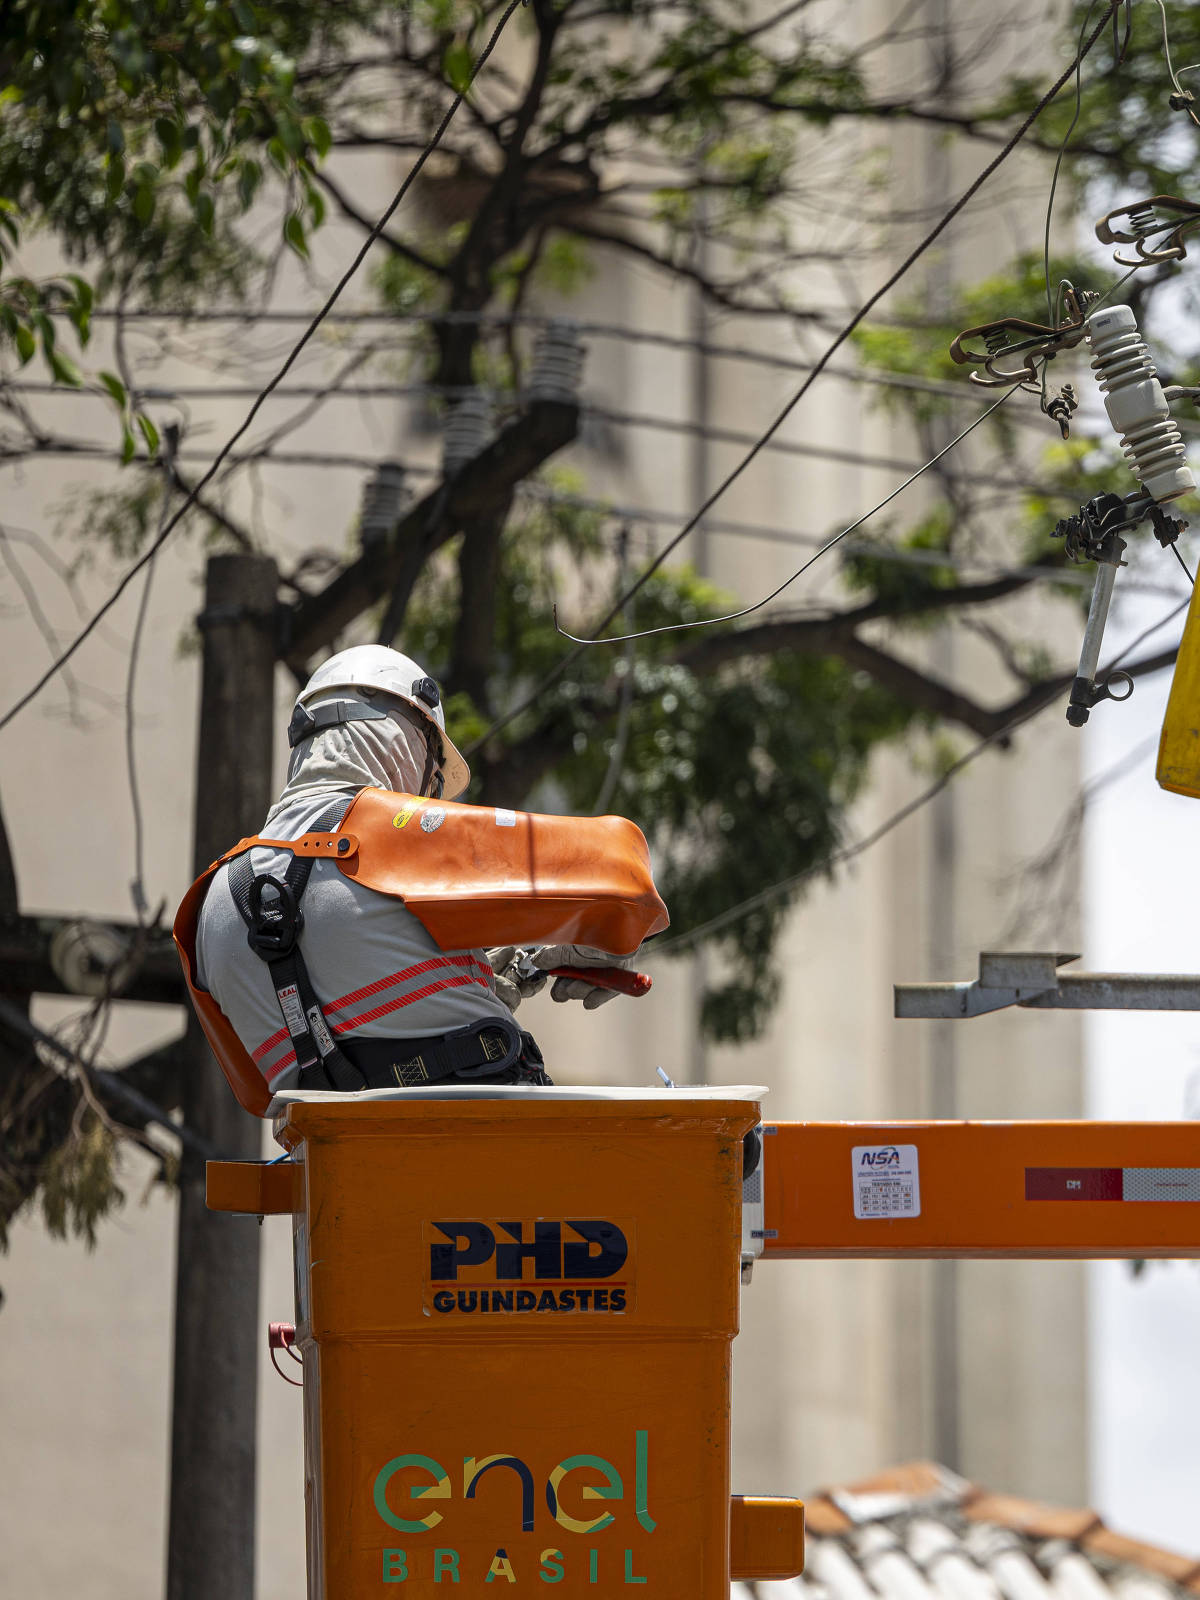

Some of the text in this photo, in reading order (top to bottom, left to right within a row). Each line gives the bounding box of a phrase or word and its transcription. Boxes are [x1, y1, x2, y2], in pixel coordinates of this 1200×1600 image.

[861, 1151, 900, 1165] NSA
[430, 1220, 628, 1280] PHD
[433, 1288, 626, 1314] GUINDASTES
[373, 1430, 657, 1534] enel
[382, 1548, 648, 1584] BRASIL
